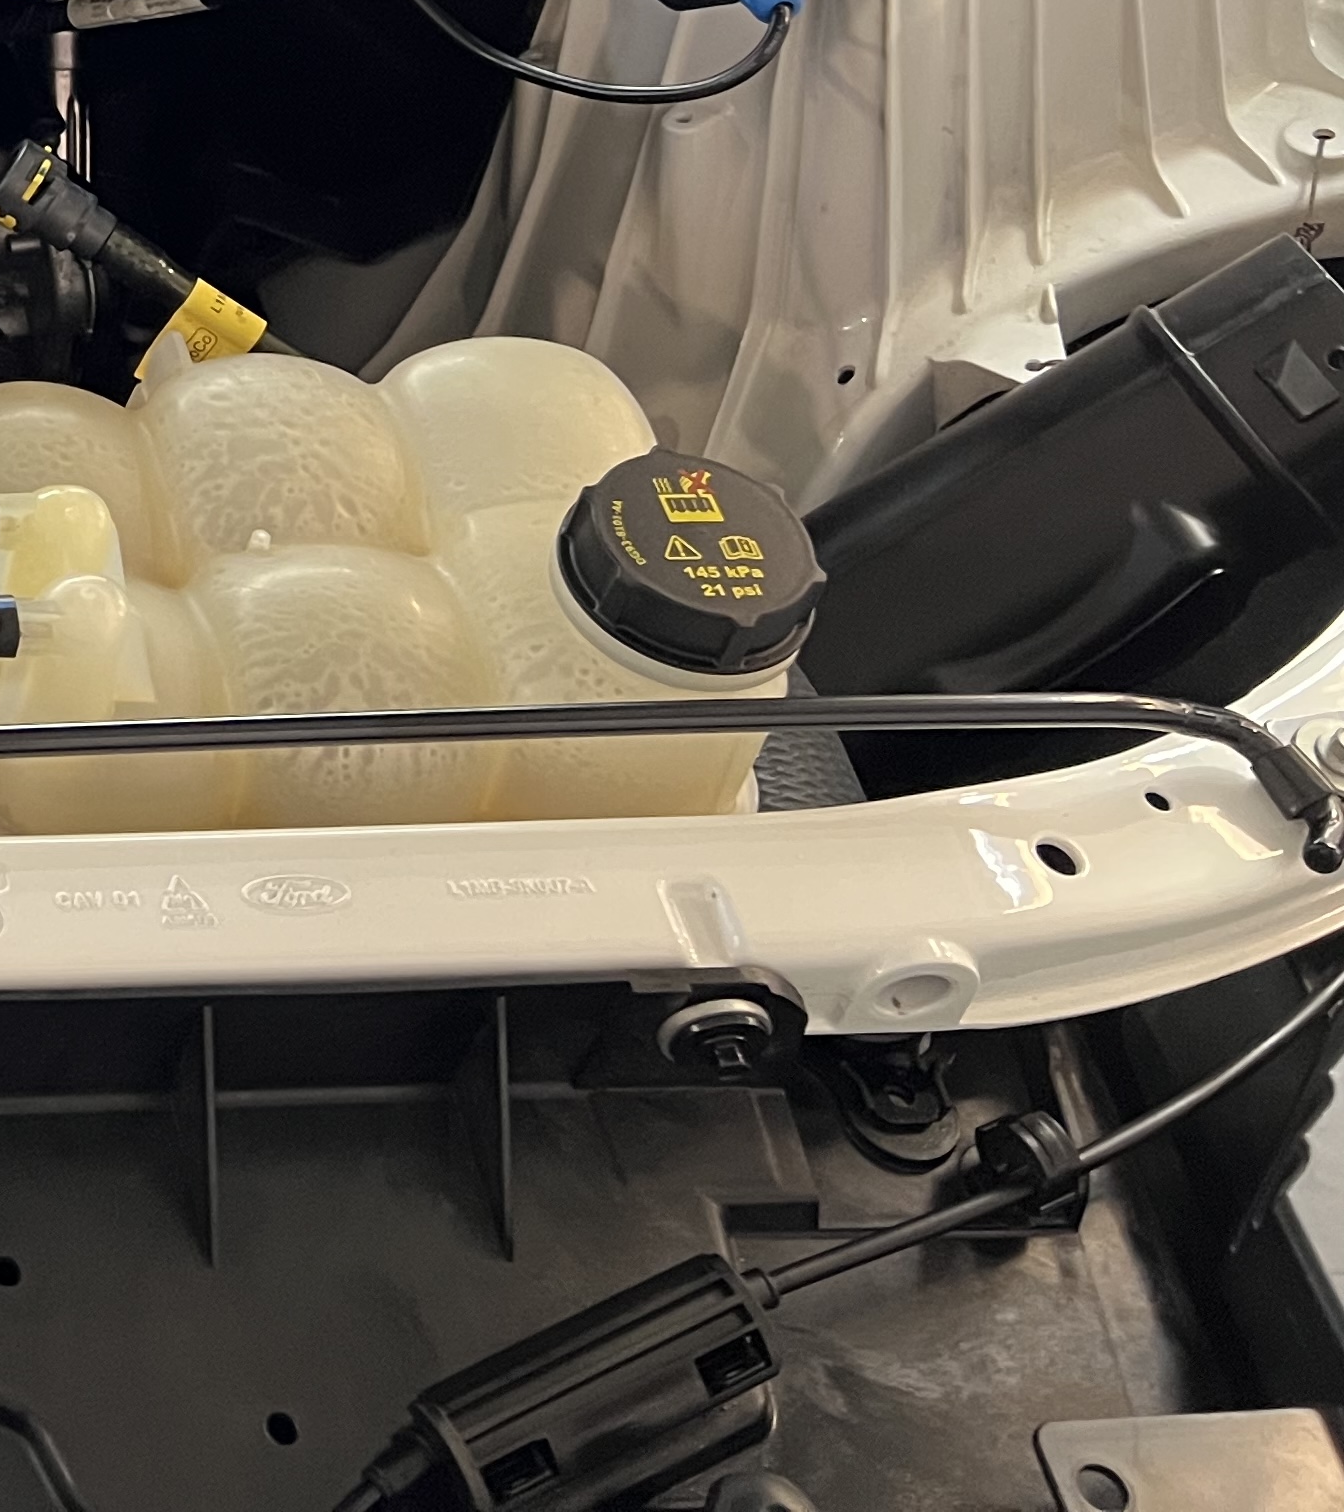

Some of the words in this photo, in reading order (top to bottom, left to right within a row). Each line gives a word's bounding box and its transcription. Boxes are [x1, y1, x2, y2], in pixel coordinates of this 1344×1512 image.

[683, 565, 721, 580] 145
[727, 564, 765, 580] kPa
[701, 583, 727, 598] 21
[731, 583, 764, 600] psi
[53, 890, 103, 911] CAV
[111, 889, 141, 909] 01
[257, 877, 335, 908] Ford
